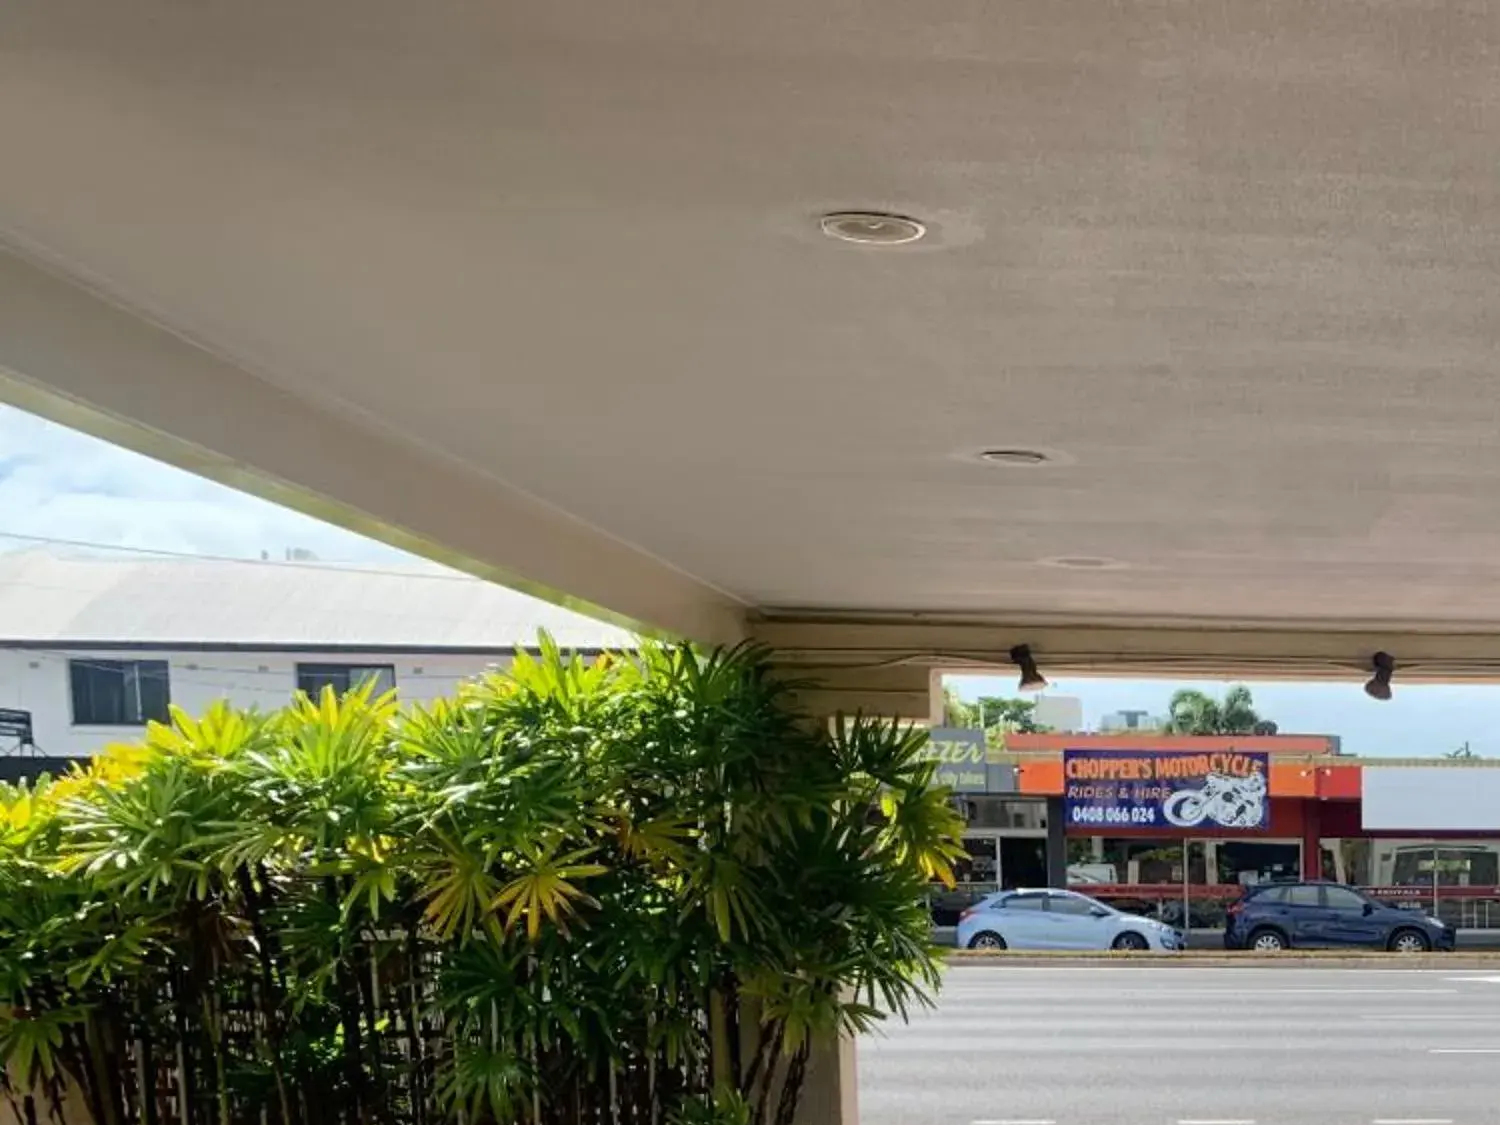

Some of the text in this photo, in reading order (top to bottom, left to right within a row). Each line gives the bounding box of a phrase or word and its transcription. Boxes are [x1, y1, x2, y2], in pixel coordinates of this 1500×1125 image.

[1067, 754, 1264, 779] CHOPPER'S MOTORCYCLE
[1068, 786, 1171, 799] RIDES & HIRE
